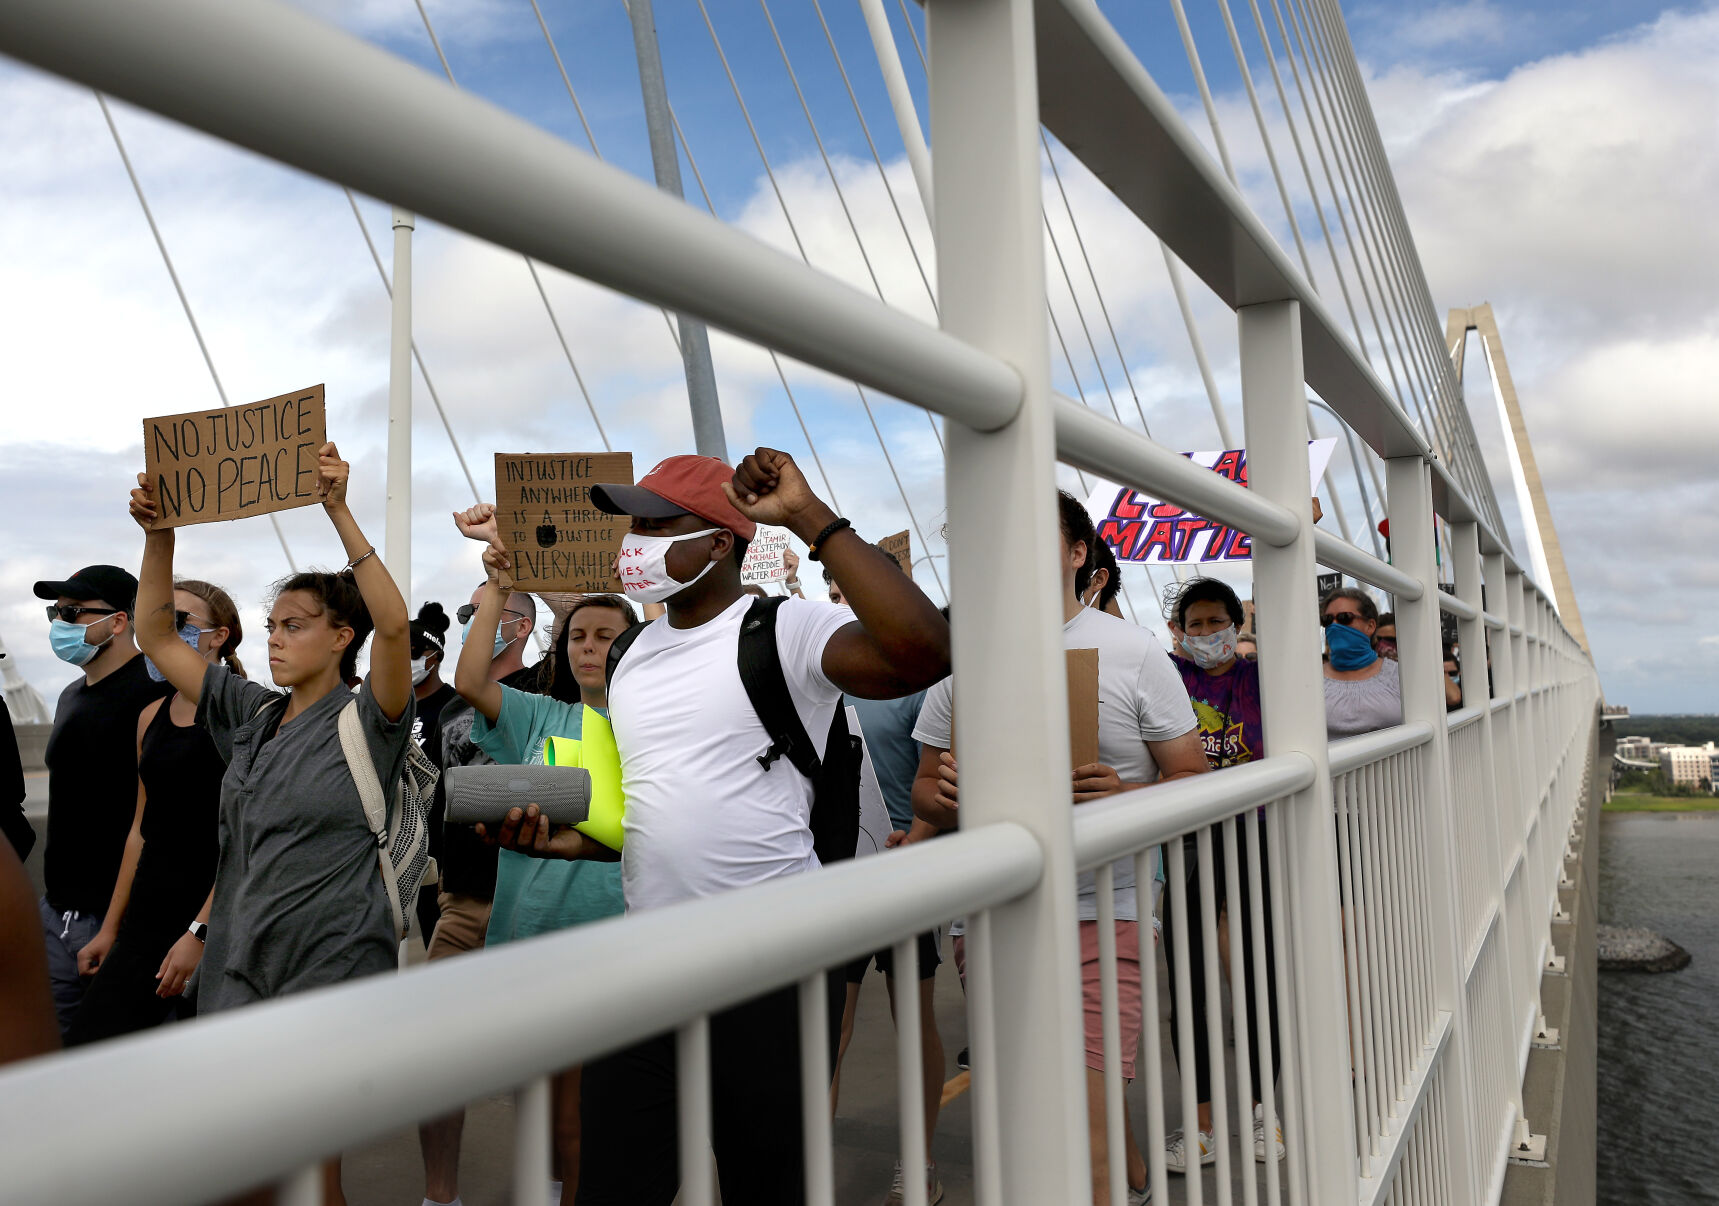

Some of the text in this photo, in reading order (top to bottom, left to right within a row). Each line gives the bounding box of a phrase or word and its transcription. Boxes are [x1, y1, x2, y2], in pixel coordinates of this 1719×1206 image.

[153, 395, 314, 464] NO JUSTICE
[505, 458, 593, 483] INJUSTICE
[159, 442, 315, 519] NO PEACE
[520, 485, 591, 504] ANYWHER
[513, 510, 527, 525] IS
[542, 509, 553, 524] A
[512, 528, 614, 544] TO JUSTICE
[1097, 518, 1253, 562] MATTE
[620, 547, 644, 558] ACK
[513, 549, 618, 582] EVERYWHER
[620, 565, 644, 576] VES
[742, 570, 769, 581] WALTER
